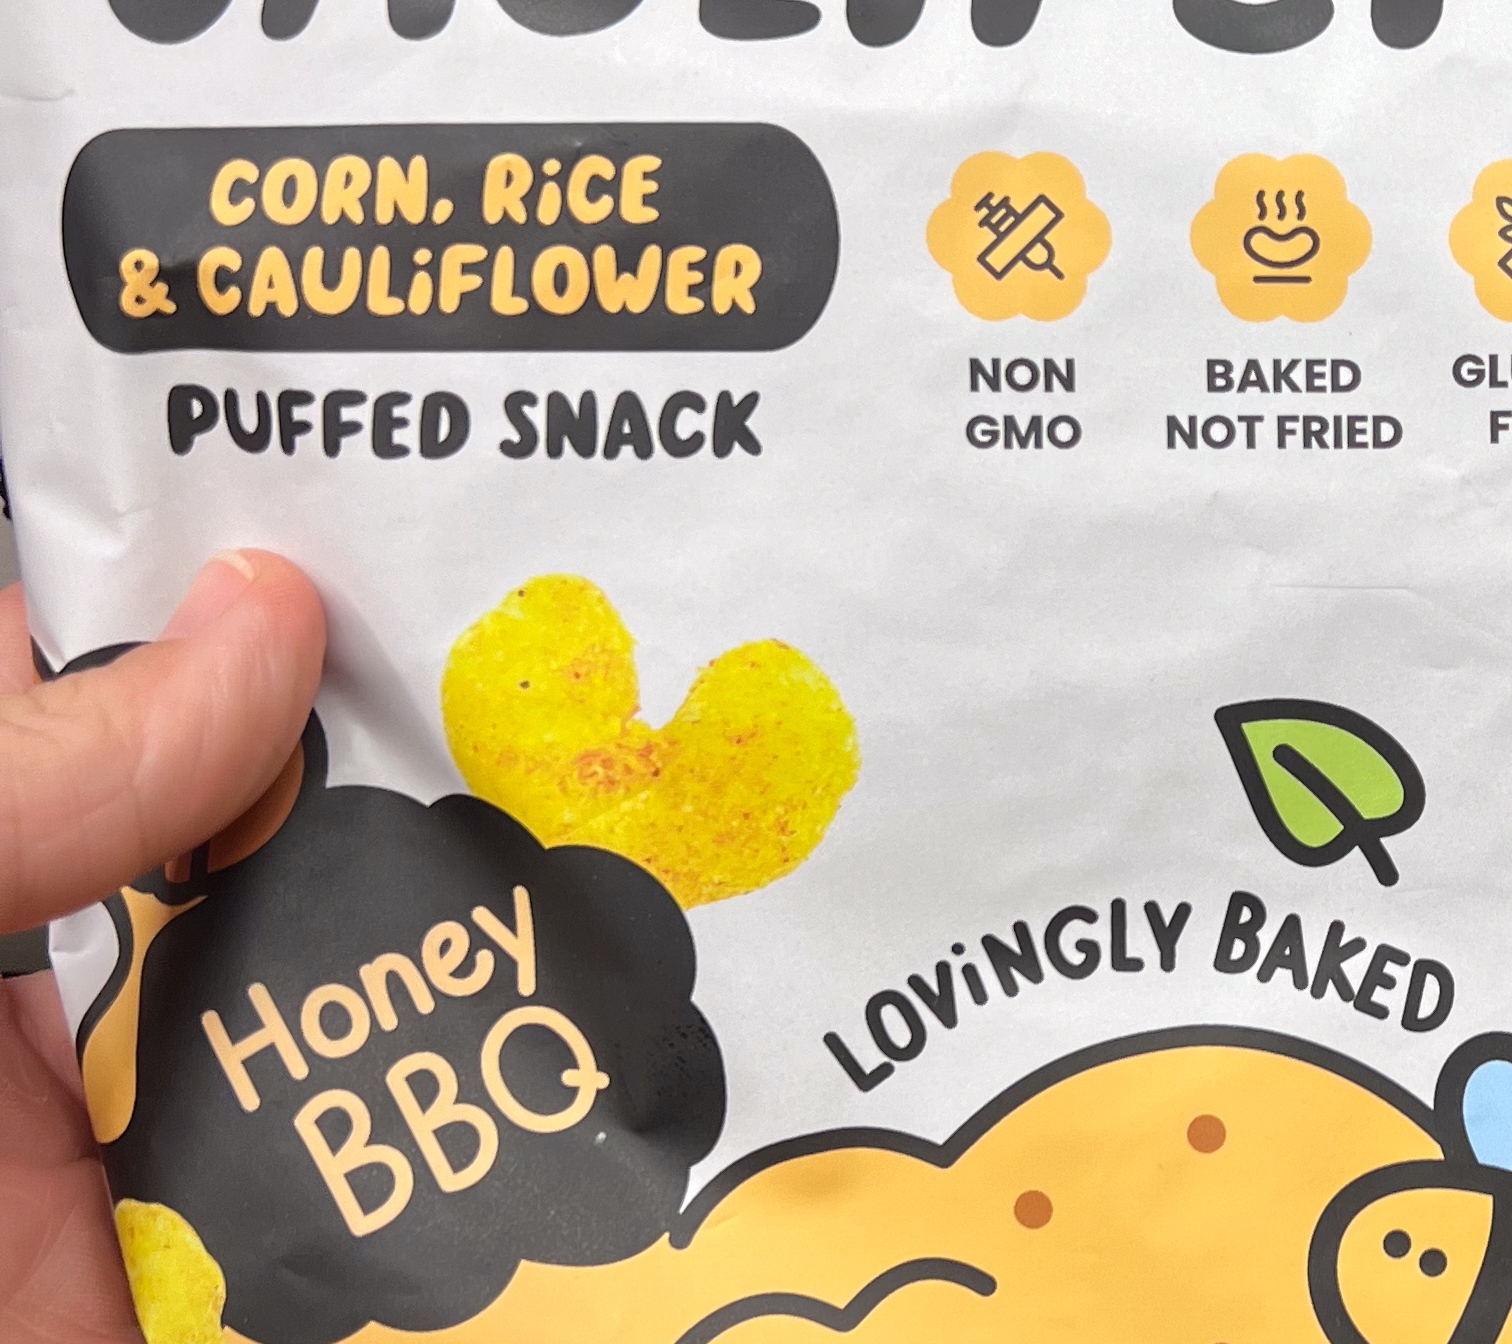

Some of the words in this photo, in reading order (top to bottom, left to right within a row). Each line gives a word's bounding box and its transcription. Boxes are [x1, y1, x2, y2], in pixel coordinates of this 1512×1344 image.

[118, 248, 177, 319] &
[968, 357, 1076, 394] NON
[1205, 357, 1362, 394] BAKED
[167, 384, 471, 458] PUFFED
[499, 389, 763, 460] SNACK
[965, 414, 1083, 451] GMO
[1166, 416, 1270, 451] NOT
[1277, 416, 1403, 452] FRIED
[1213, 890, 1455, 1033] BAKED
[201, 884, 538, 1113] Honey
[293, 1005, 611, 1238] BBQ
